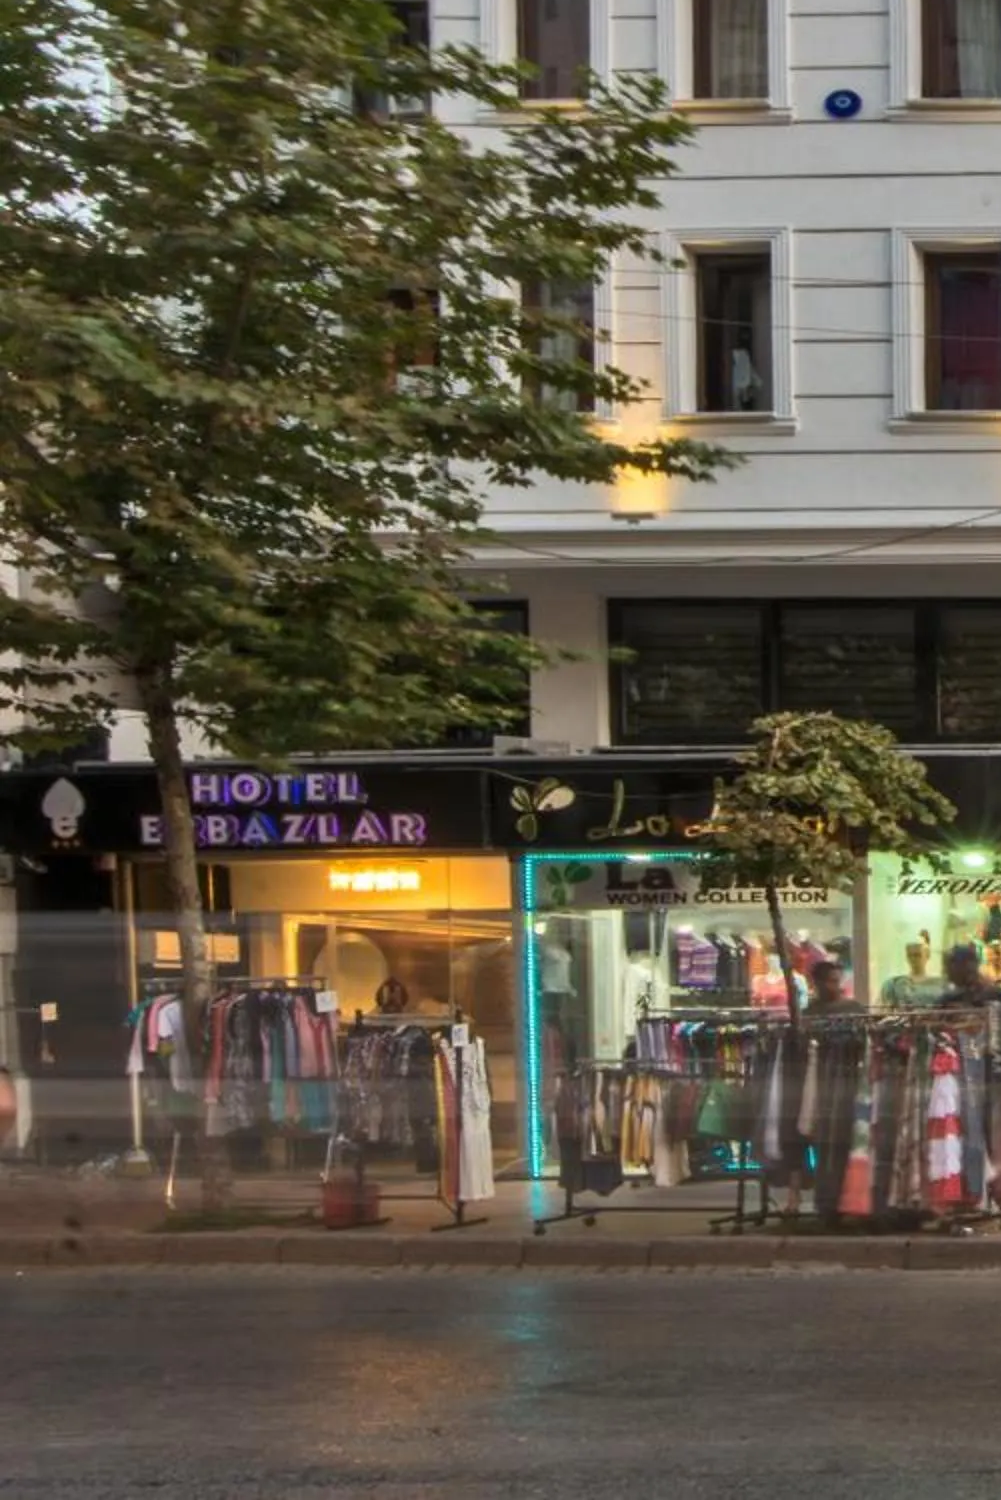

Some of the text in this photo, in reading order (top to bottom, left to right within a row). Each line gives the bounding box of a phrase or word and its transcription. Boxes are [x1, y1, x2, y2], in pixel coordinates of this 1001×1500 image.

[192, 773, 363, 803] HOTEL
[140, 813, 426, 845] EBAZLAR
[606, 891, 687, 905] WOMEN
